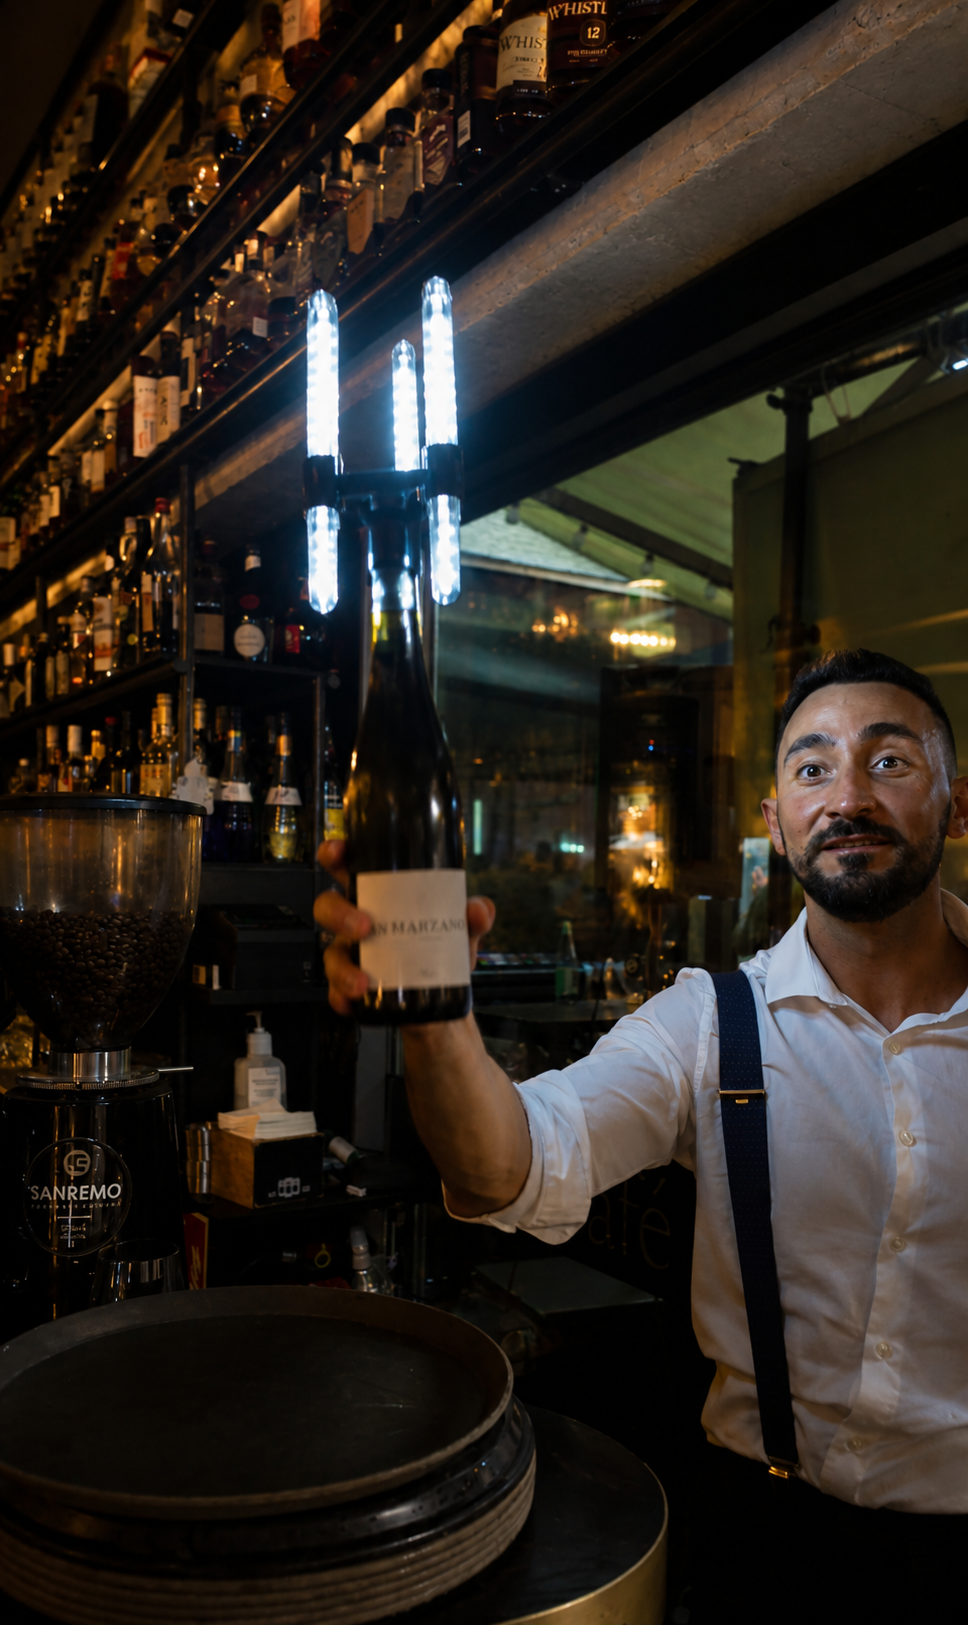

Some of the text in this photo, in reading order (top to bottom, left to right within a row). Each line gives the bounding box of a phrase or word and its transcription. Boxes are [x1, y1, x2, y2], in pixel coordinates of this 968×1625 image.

[587, 26, 600, 39] 12
[369, 919, 465, 936] AN MARZANO
[30, 1183, 122, 1201] SANREMO
[587, 1173, 671, 1270] afé
